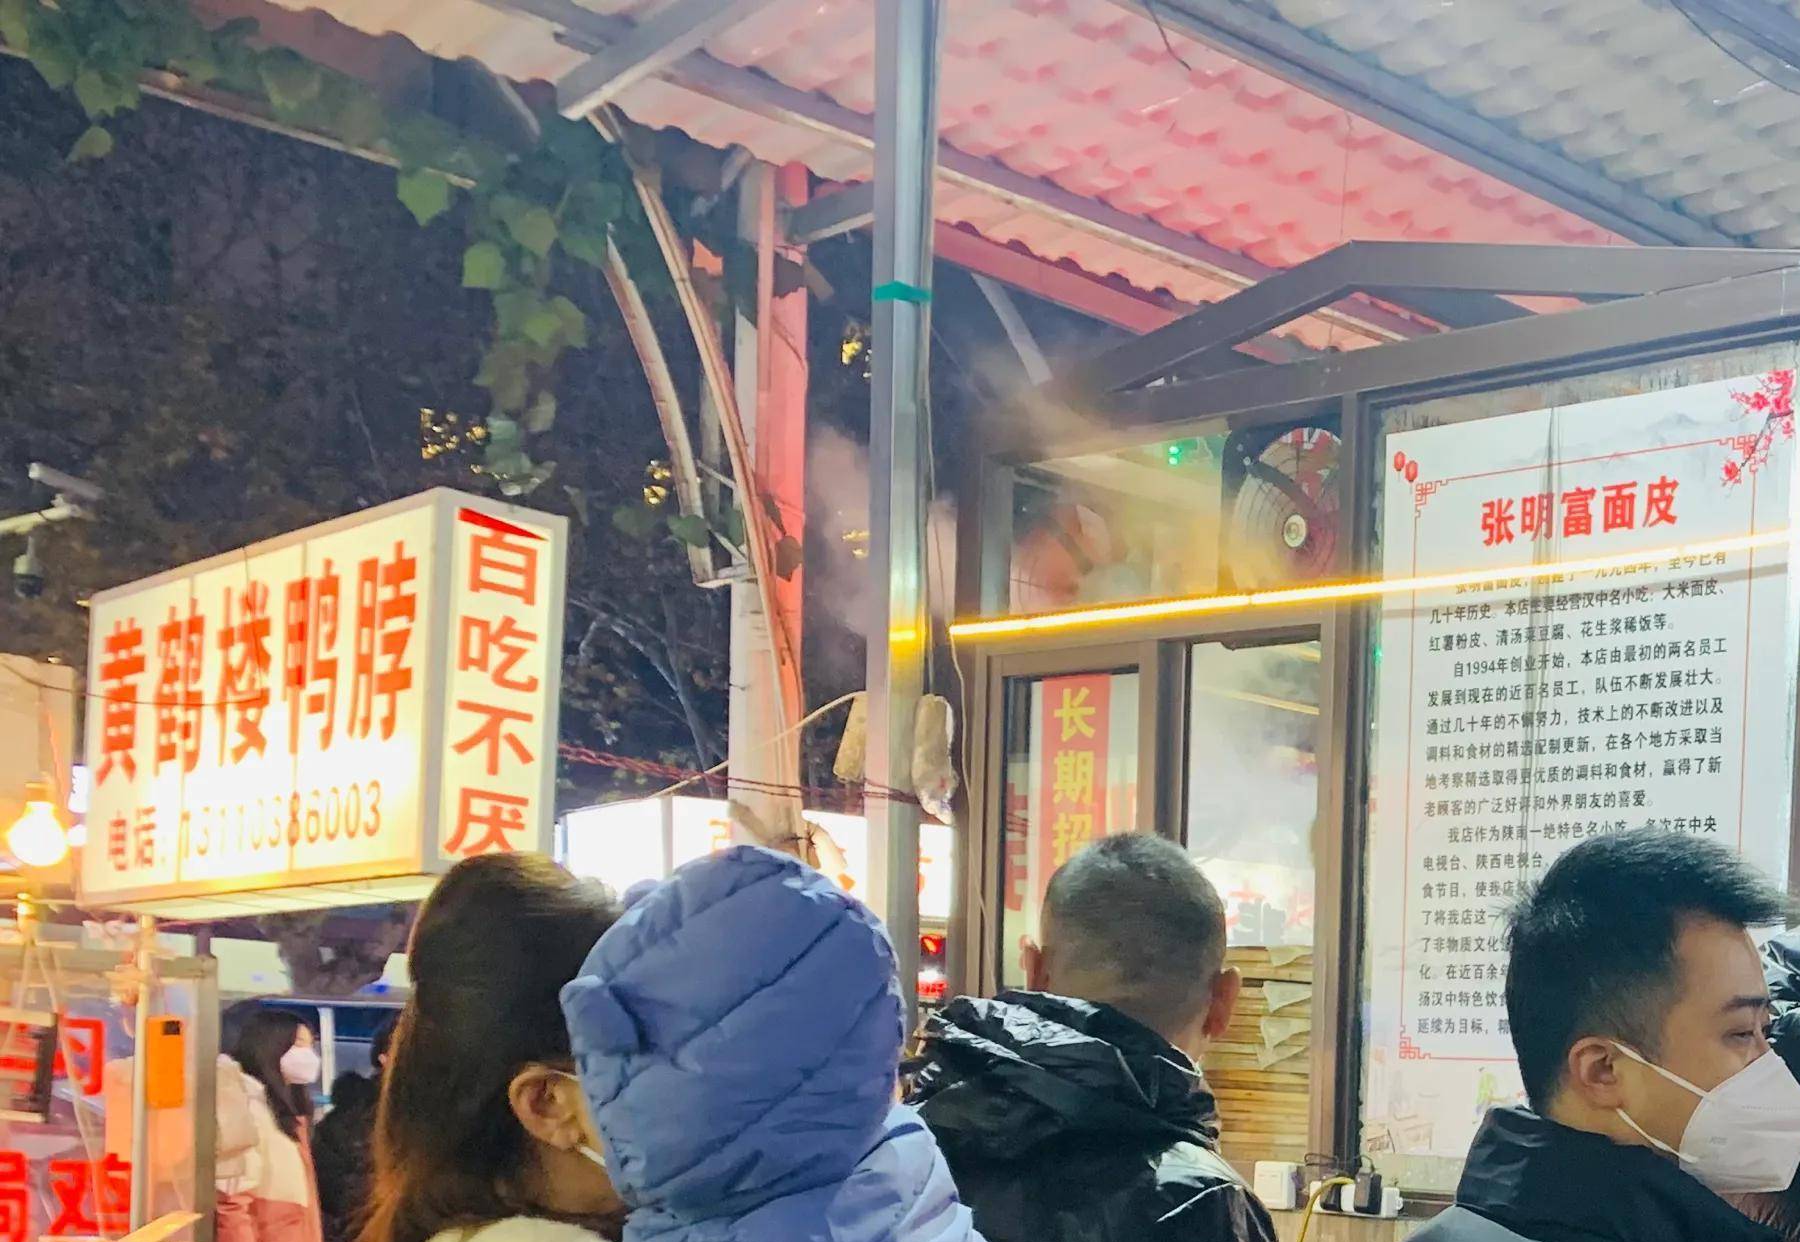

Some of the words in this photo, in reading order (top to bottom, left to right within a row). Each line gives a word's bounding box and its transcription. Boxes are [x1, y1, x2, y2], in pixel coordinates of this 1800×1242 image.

[1480, 473, 1681, 547] 张明富面皮
[96, 540, 417, 787] 黄鹤楼鸭脖
[444, 507, 547, 853] 百吃不厌
